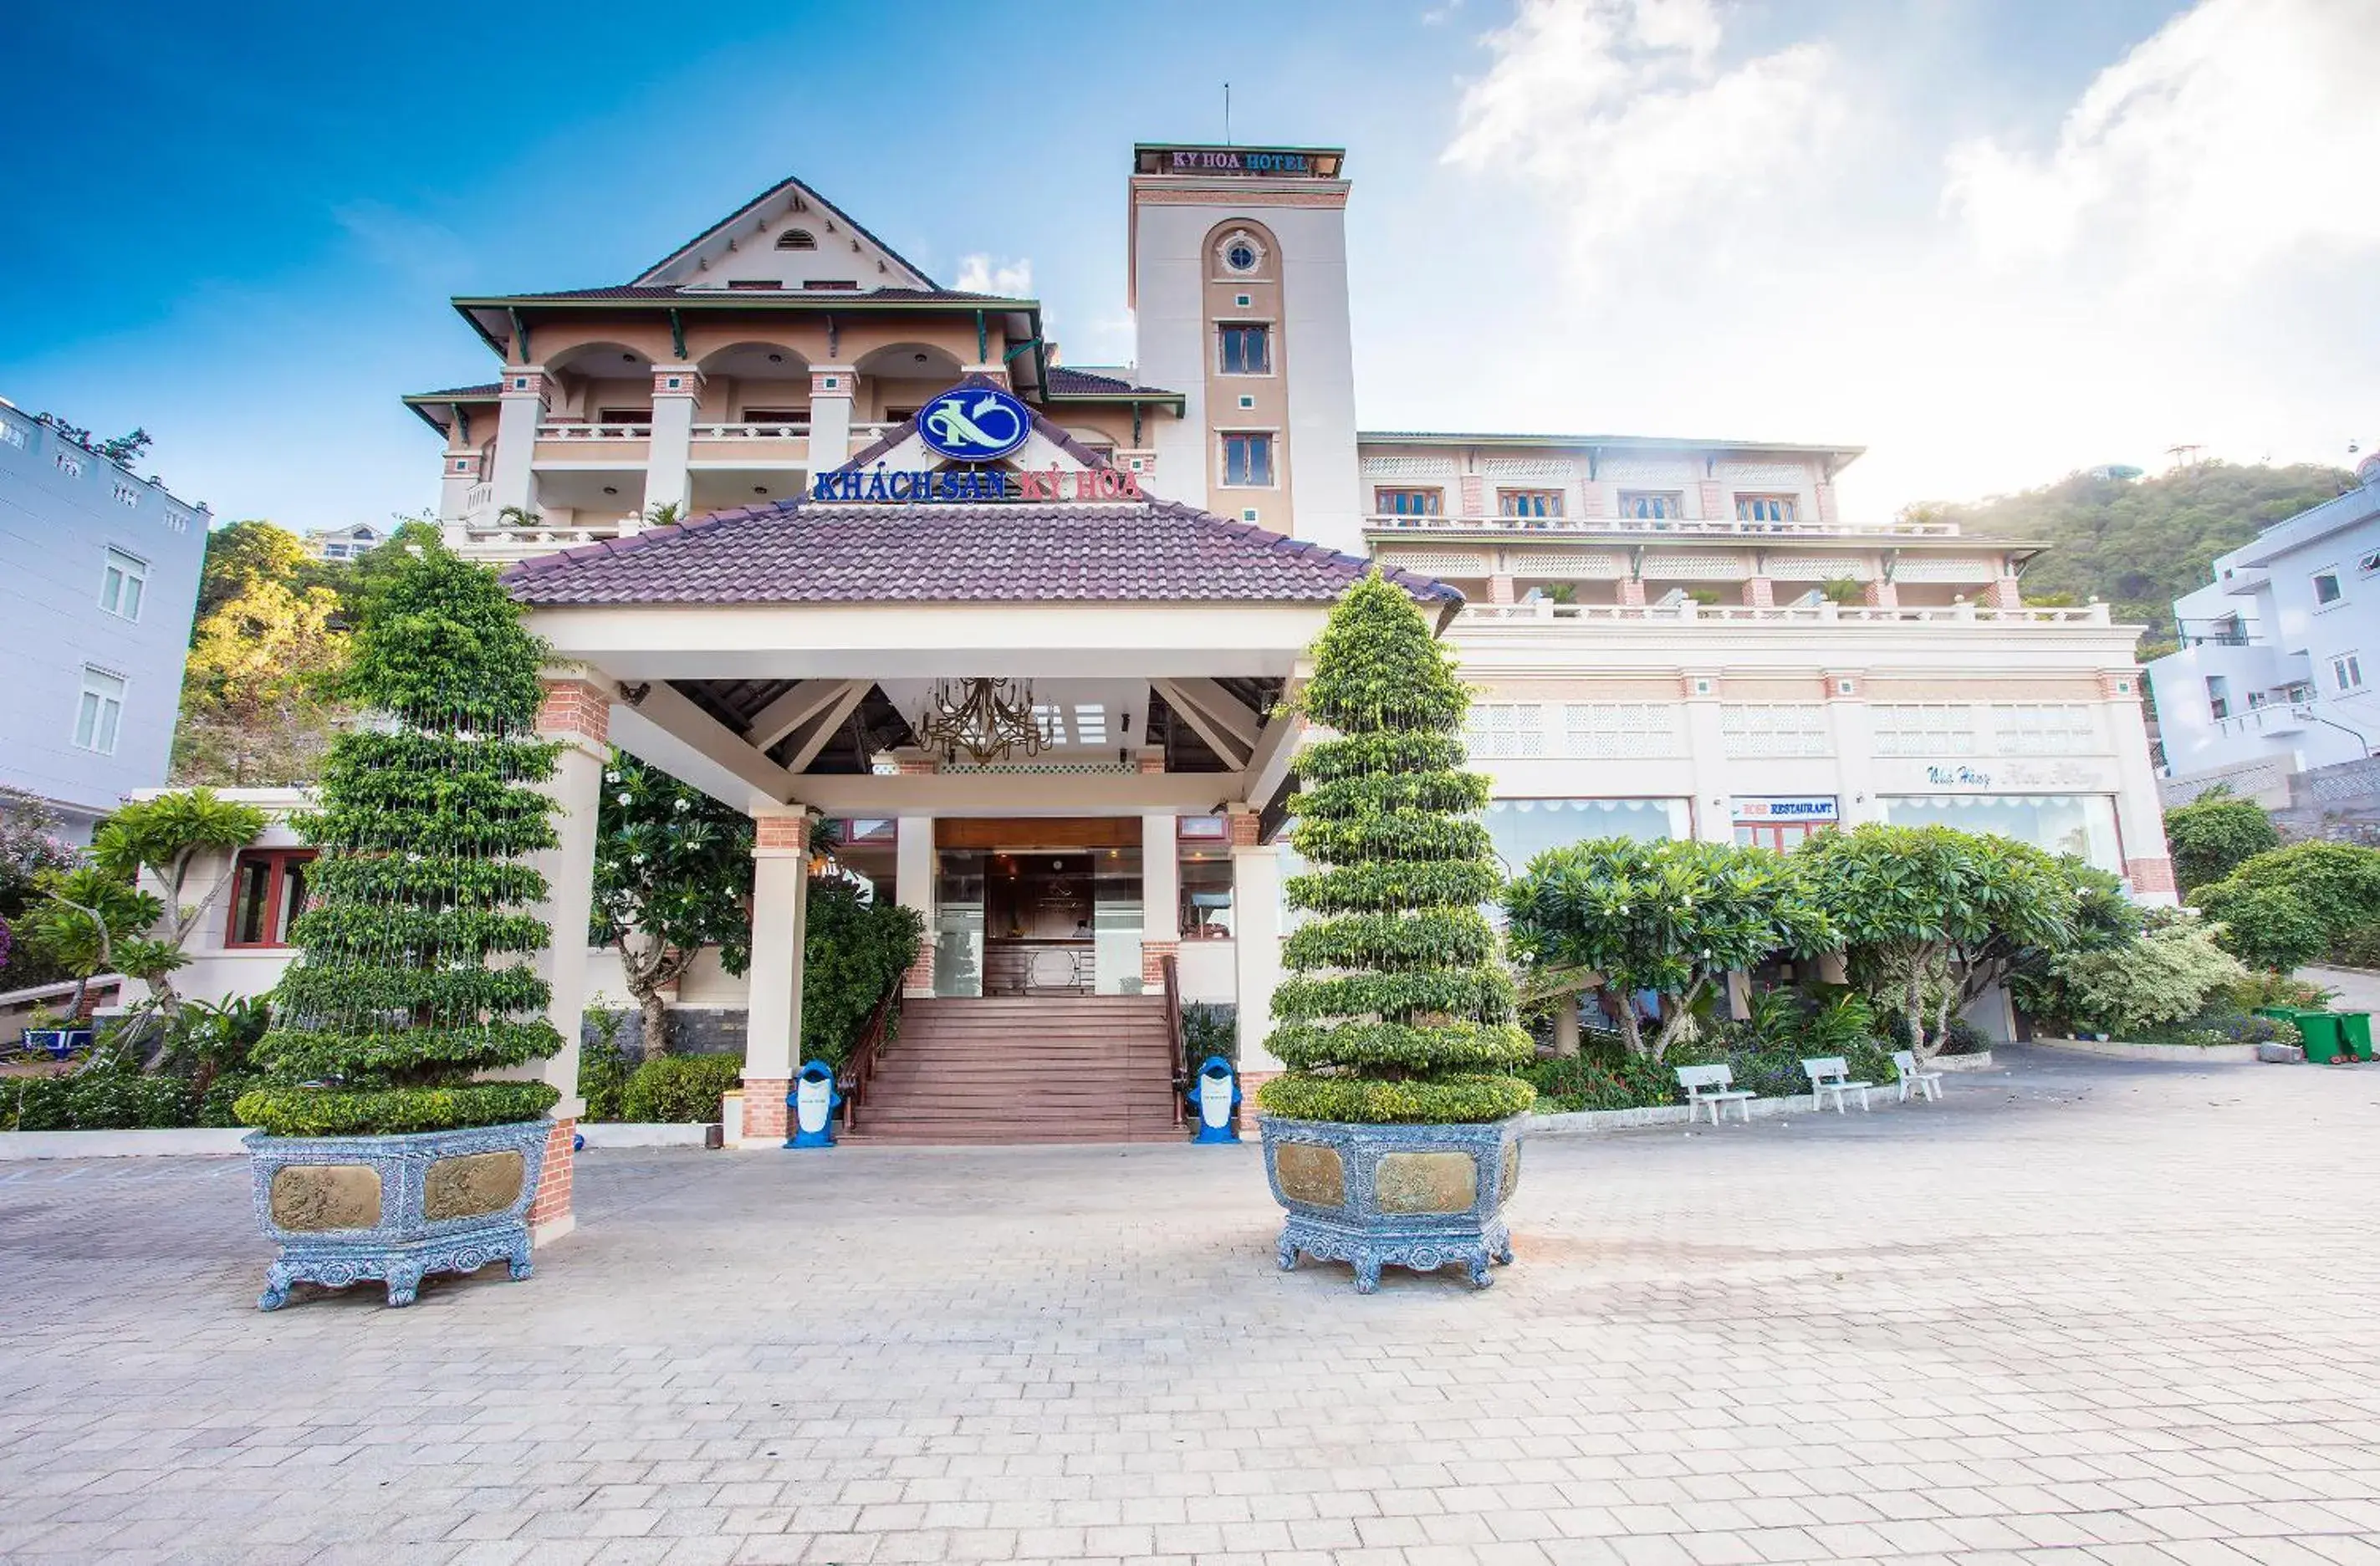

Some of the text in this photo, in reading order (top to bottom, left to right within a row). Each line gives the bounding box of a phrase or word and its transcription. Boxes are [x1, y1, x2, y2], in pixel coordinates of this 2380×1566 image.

[1172, 152, 1307, 171] KY HOA HOTEL
[1770, 803, 1833, 814] RESTAURANT
